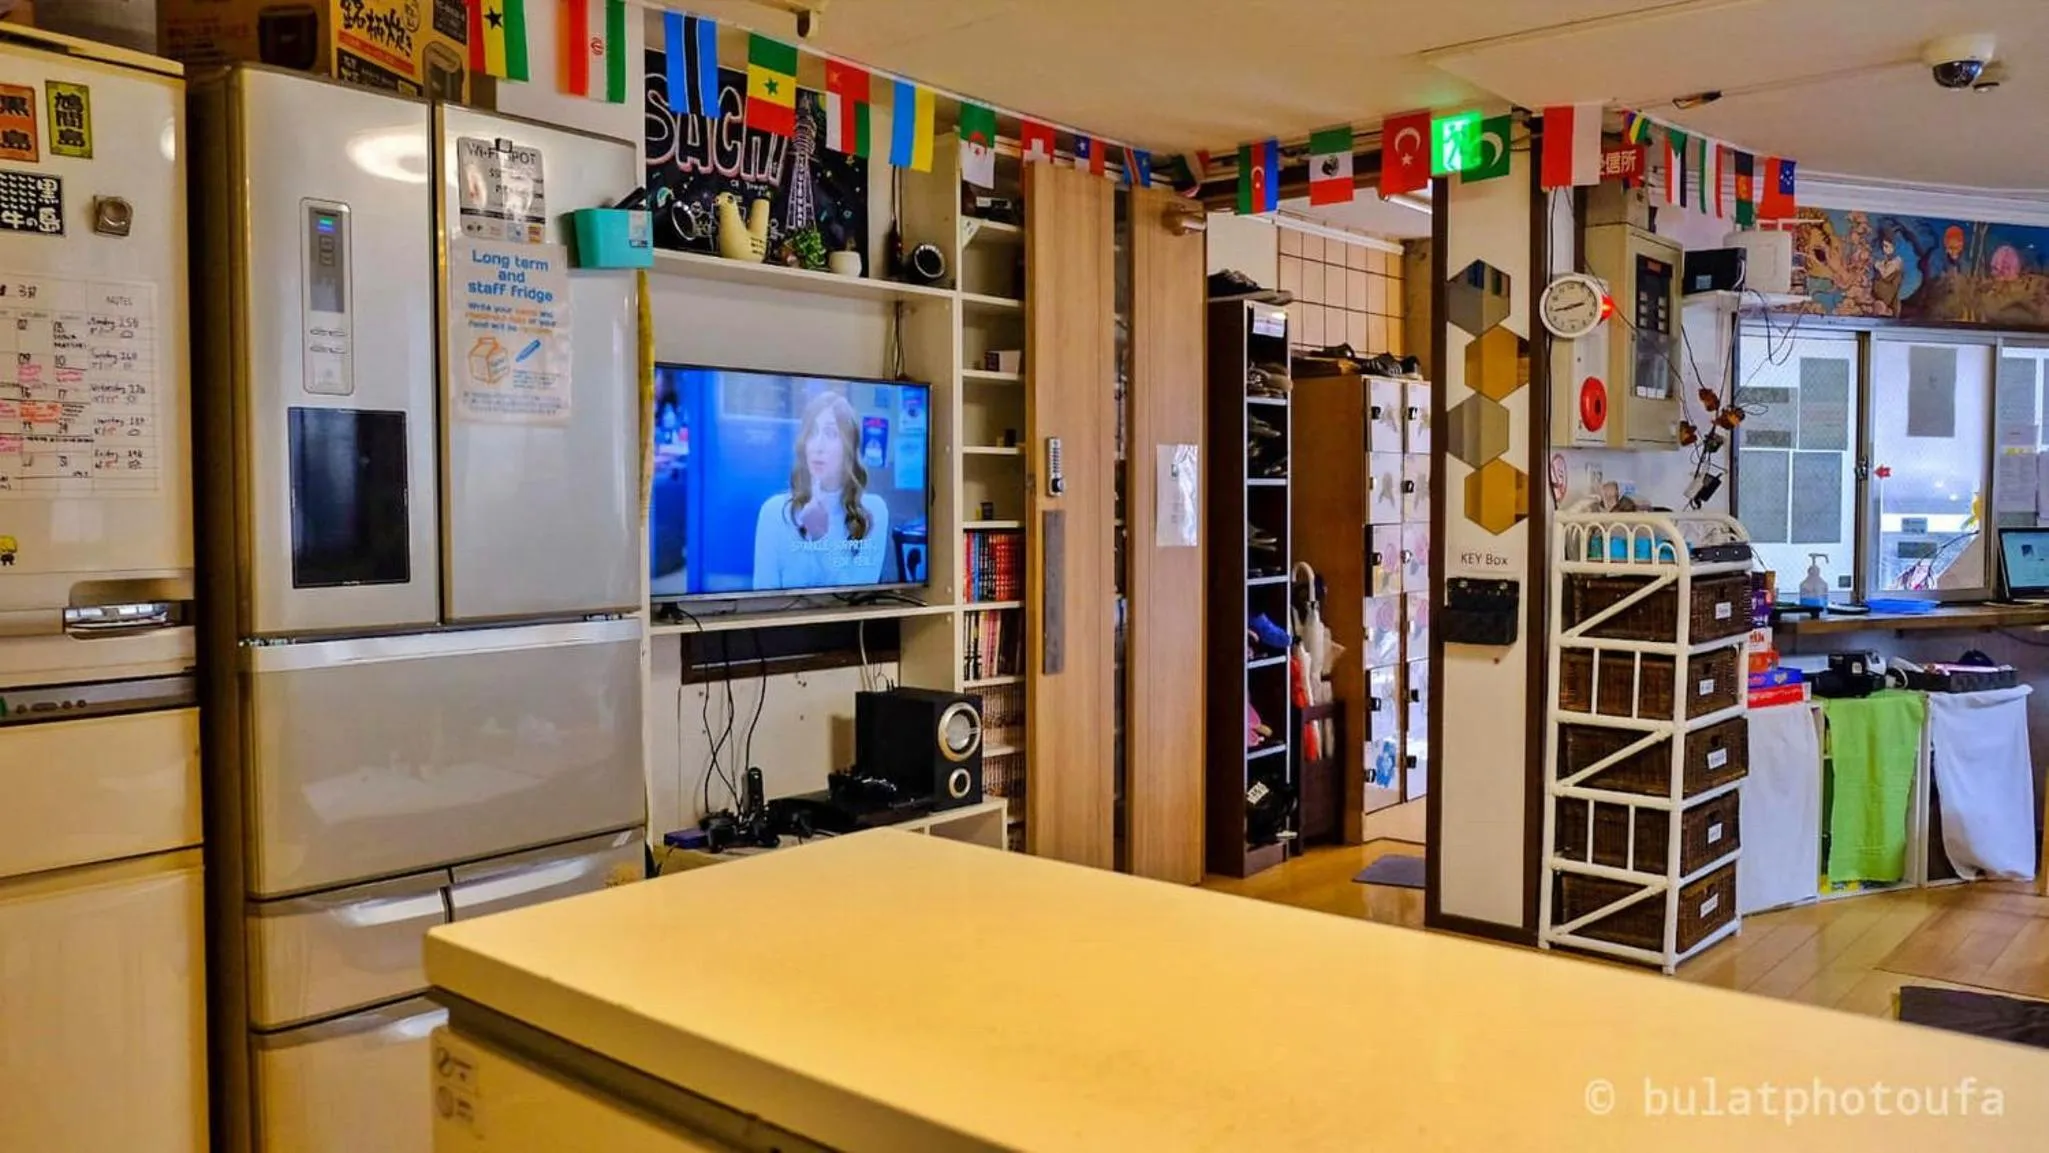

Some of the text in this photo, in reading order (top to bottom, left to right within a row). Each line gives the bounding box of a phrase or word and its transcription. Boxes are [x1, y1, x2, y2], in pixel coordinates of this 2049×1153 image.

[472, 249, 549, 272] Long term
[497, 270, 525, 283] and
[467, 280, 553, 304] staff fridge
[1460, 553, 1508, 566] KEY Box
